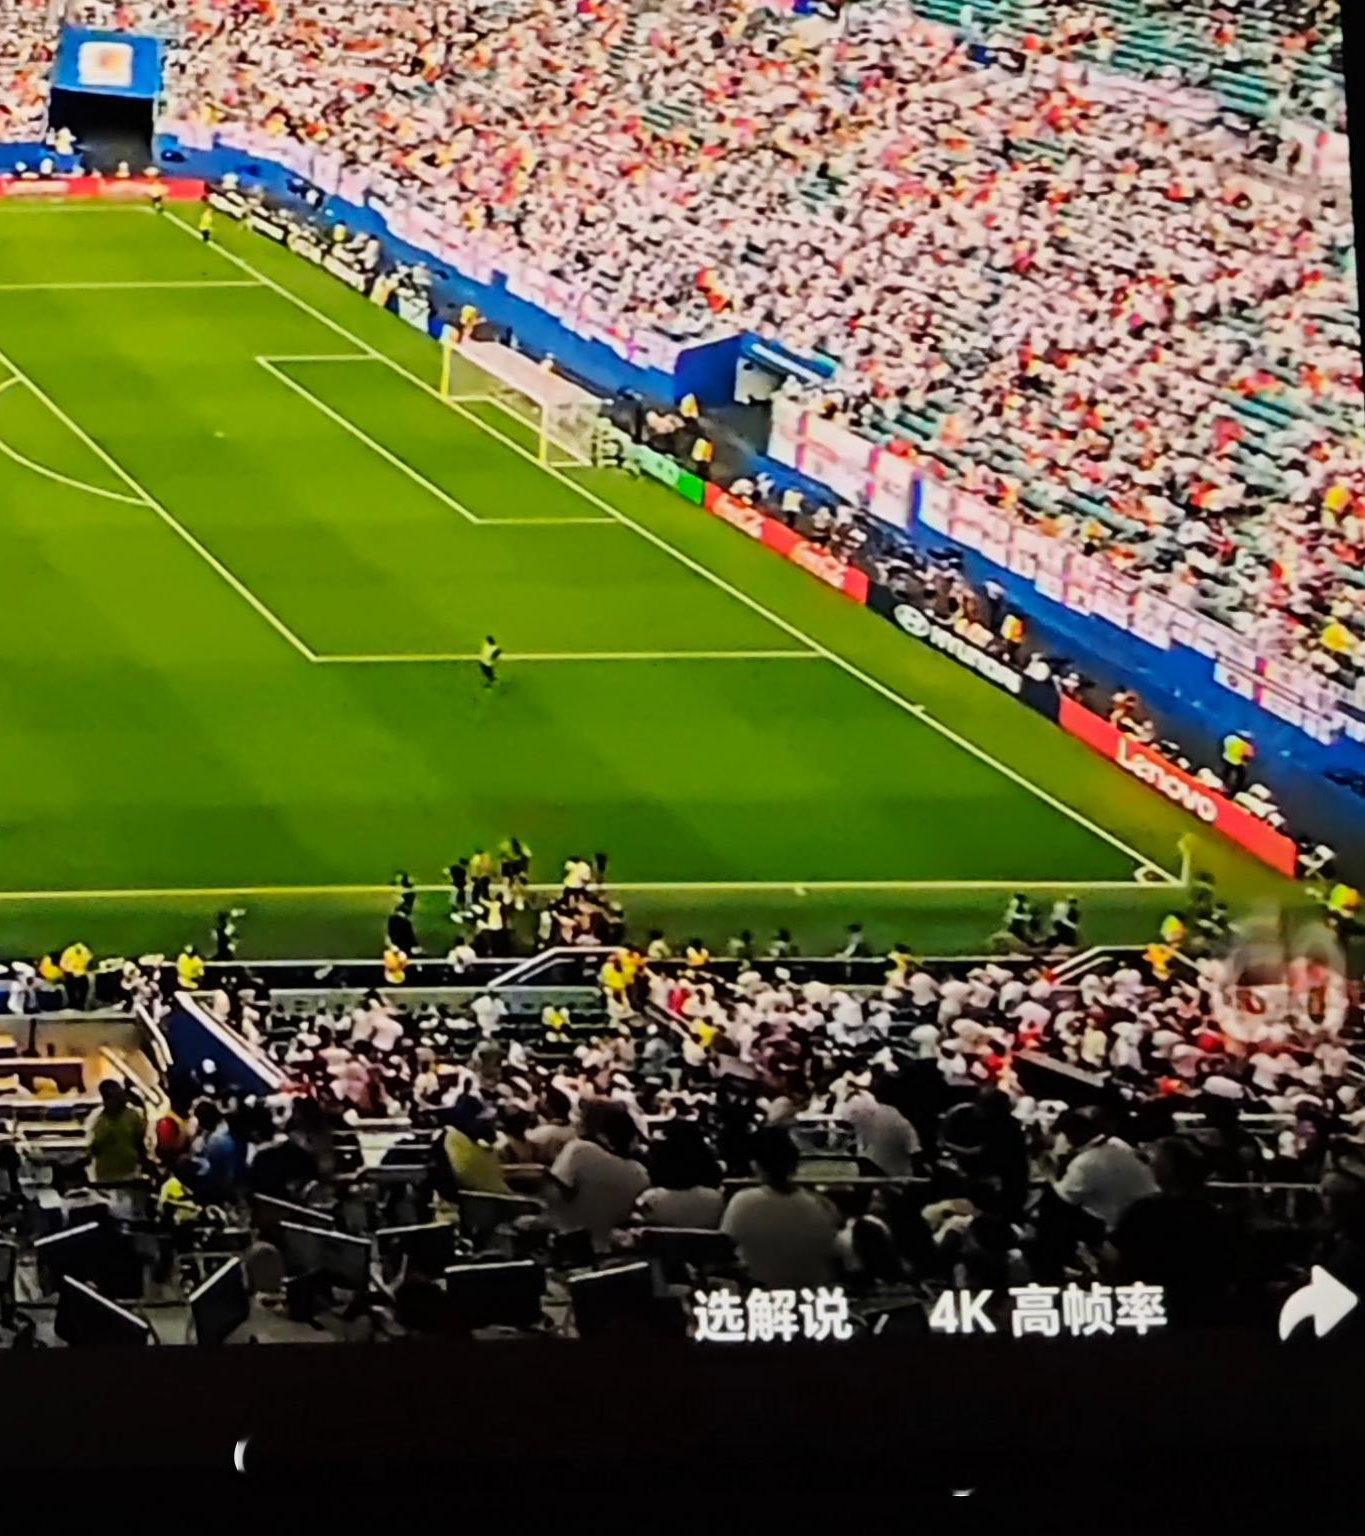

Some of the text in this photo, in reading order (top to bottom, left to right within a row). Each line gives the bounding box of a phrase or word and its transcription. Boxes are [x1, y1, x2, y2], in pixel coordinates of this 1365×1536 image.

[1117, 735, 1218, 823] Lenovo
[694, 1286, 853, 1342] 选解说
[929, 1281, 1168, 1337] 4K 高帧率
